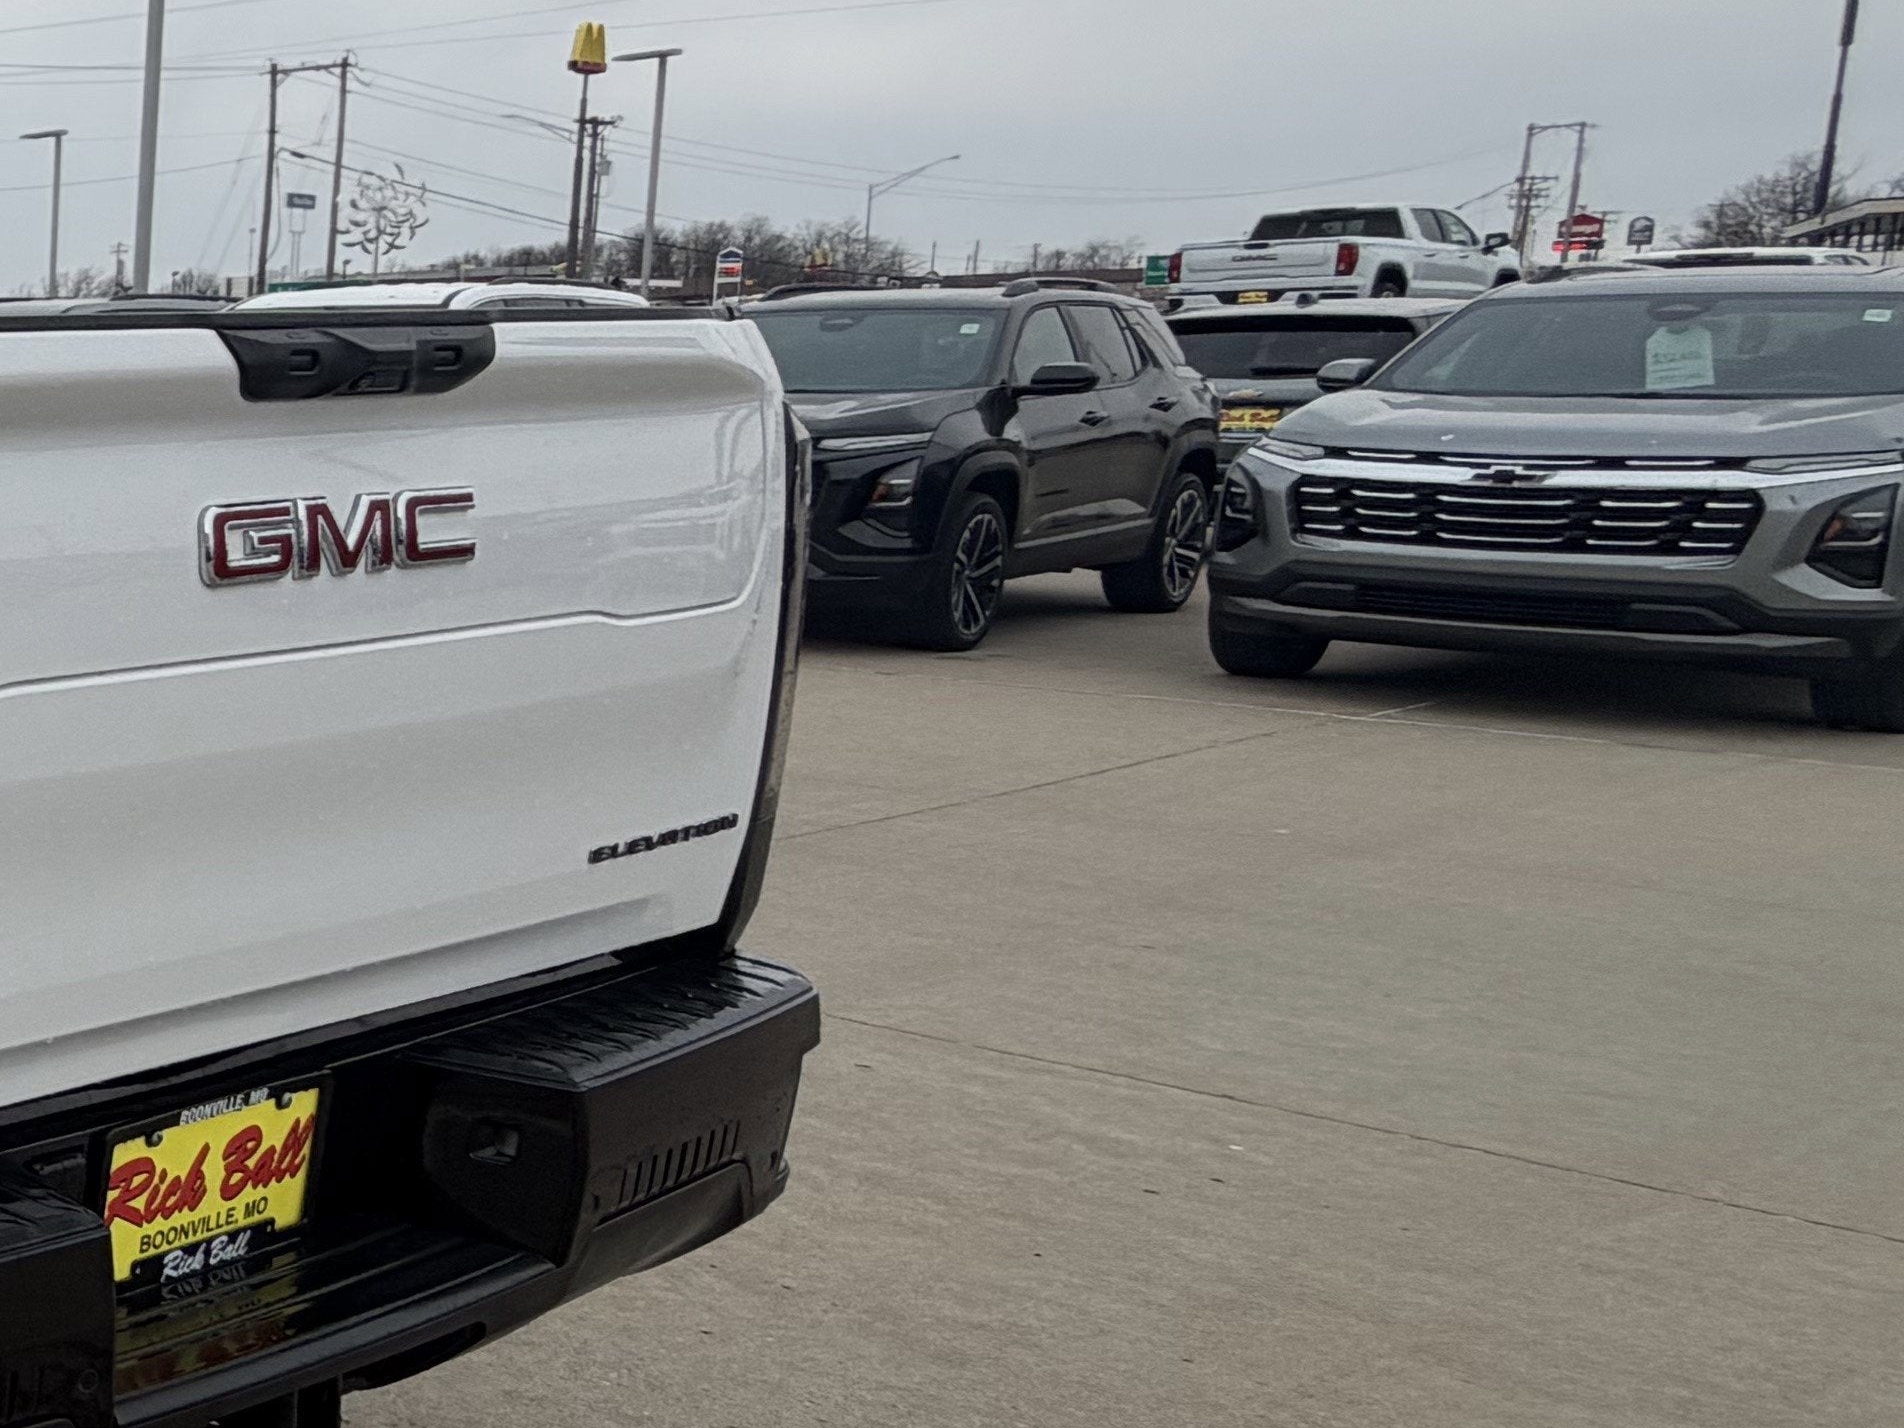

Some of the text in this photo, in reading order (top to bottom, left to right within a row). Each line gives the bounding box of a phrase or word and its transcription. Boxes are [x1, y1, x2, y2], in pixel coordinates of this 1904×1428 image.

[198, 486, 477, 589] GMC
[588, 813, 739, 864] ELEVATION
[103, 1113, 316, 1228] Rick Ball
[243, 1196, 269, 1220] MO
[160, 1242, 208, 1283] Rick
[209, 1229, 252, 1266] Ball
